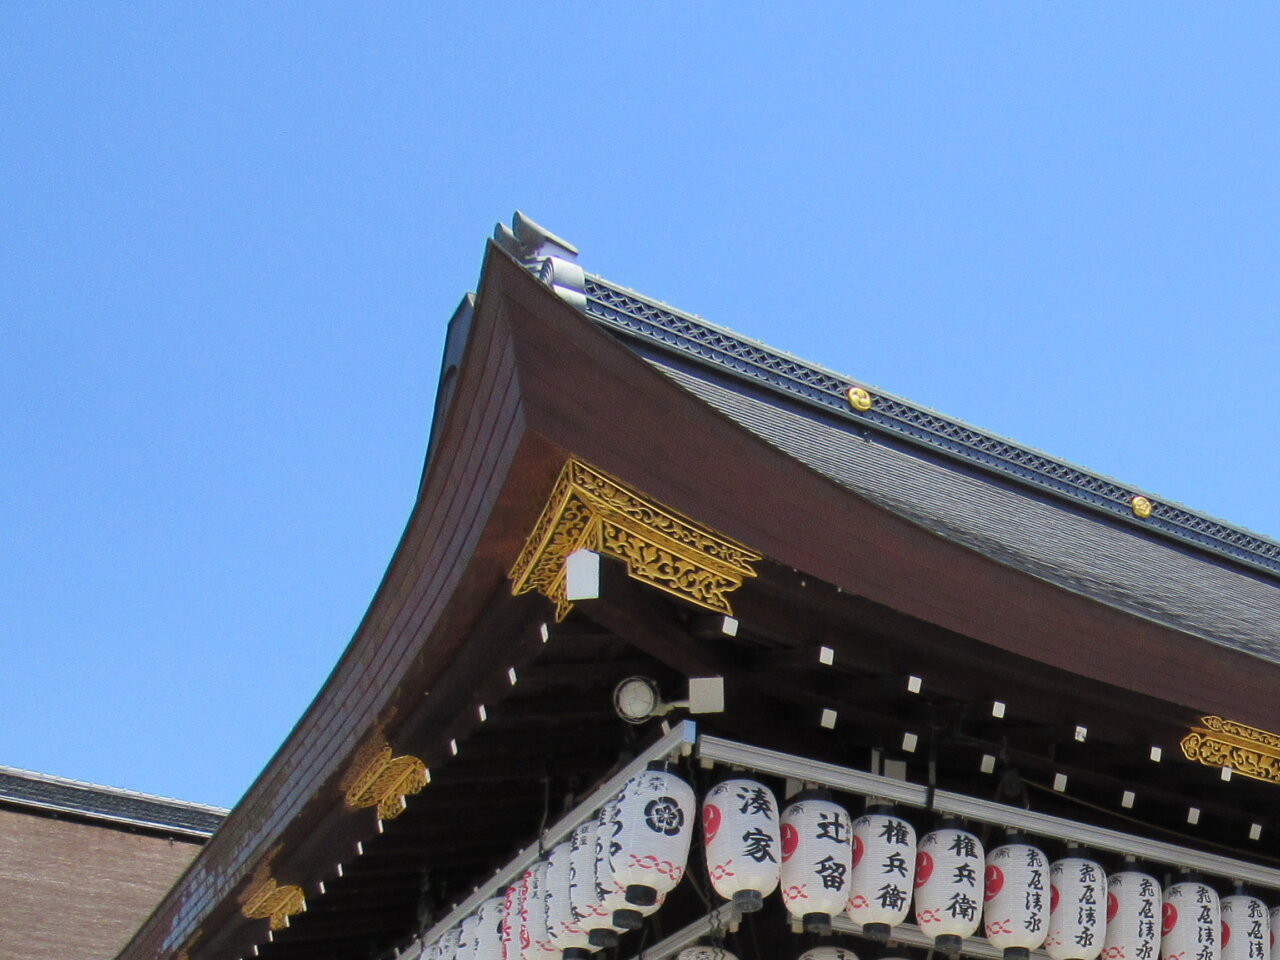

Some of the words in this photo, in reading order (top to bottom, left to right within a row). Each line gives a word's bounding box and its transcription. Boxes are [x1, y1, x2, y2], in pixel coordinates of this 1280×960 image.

[736, 786, 778, 865] 湊家
[816, 811, 847, 893] 辻留
[876, 819, 911, 913] 権兵衛
[945, 833, 979, 923] 権兵衛
